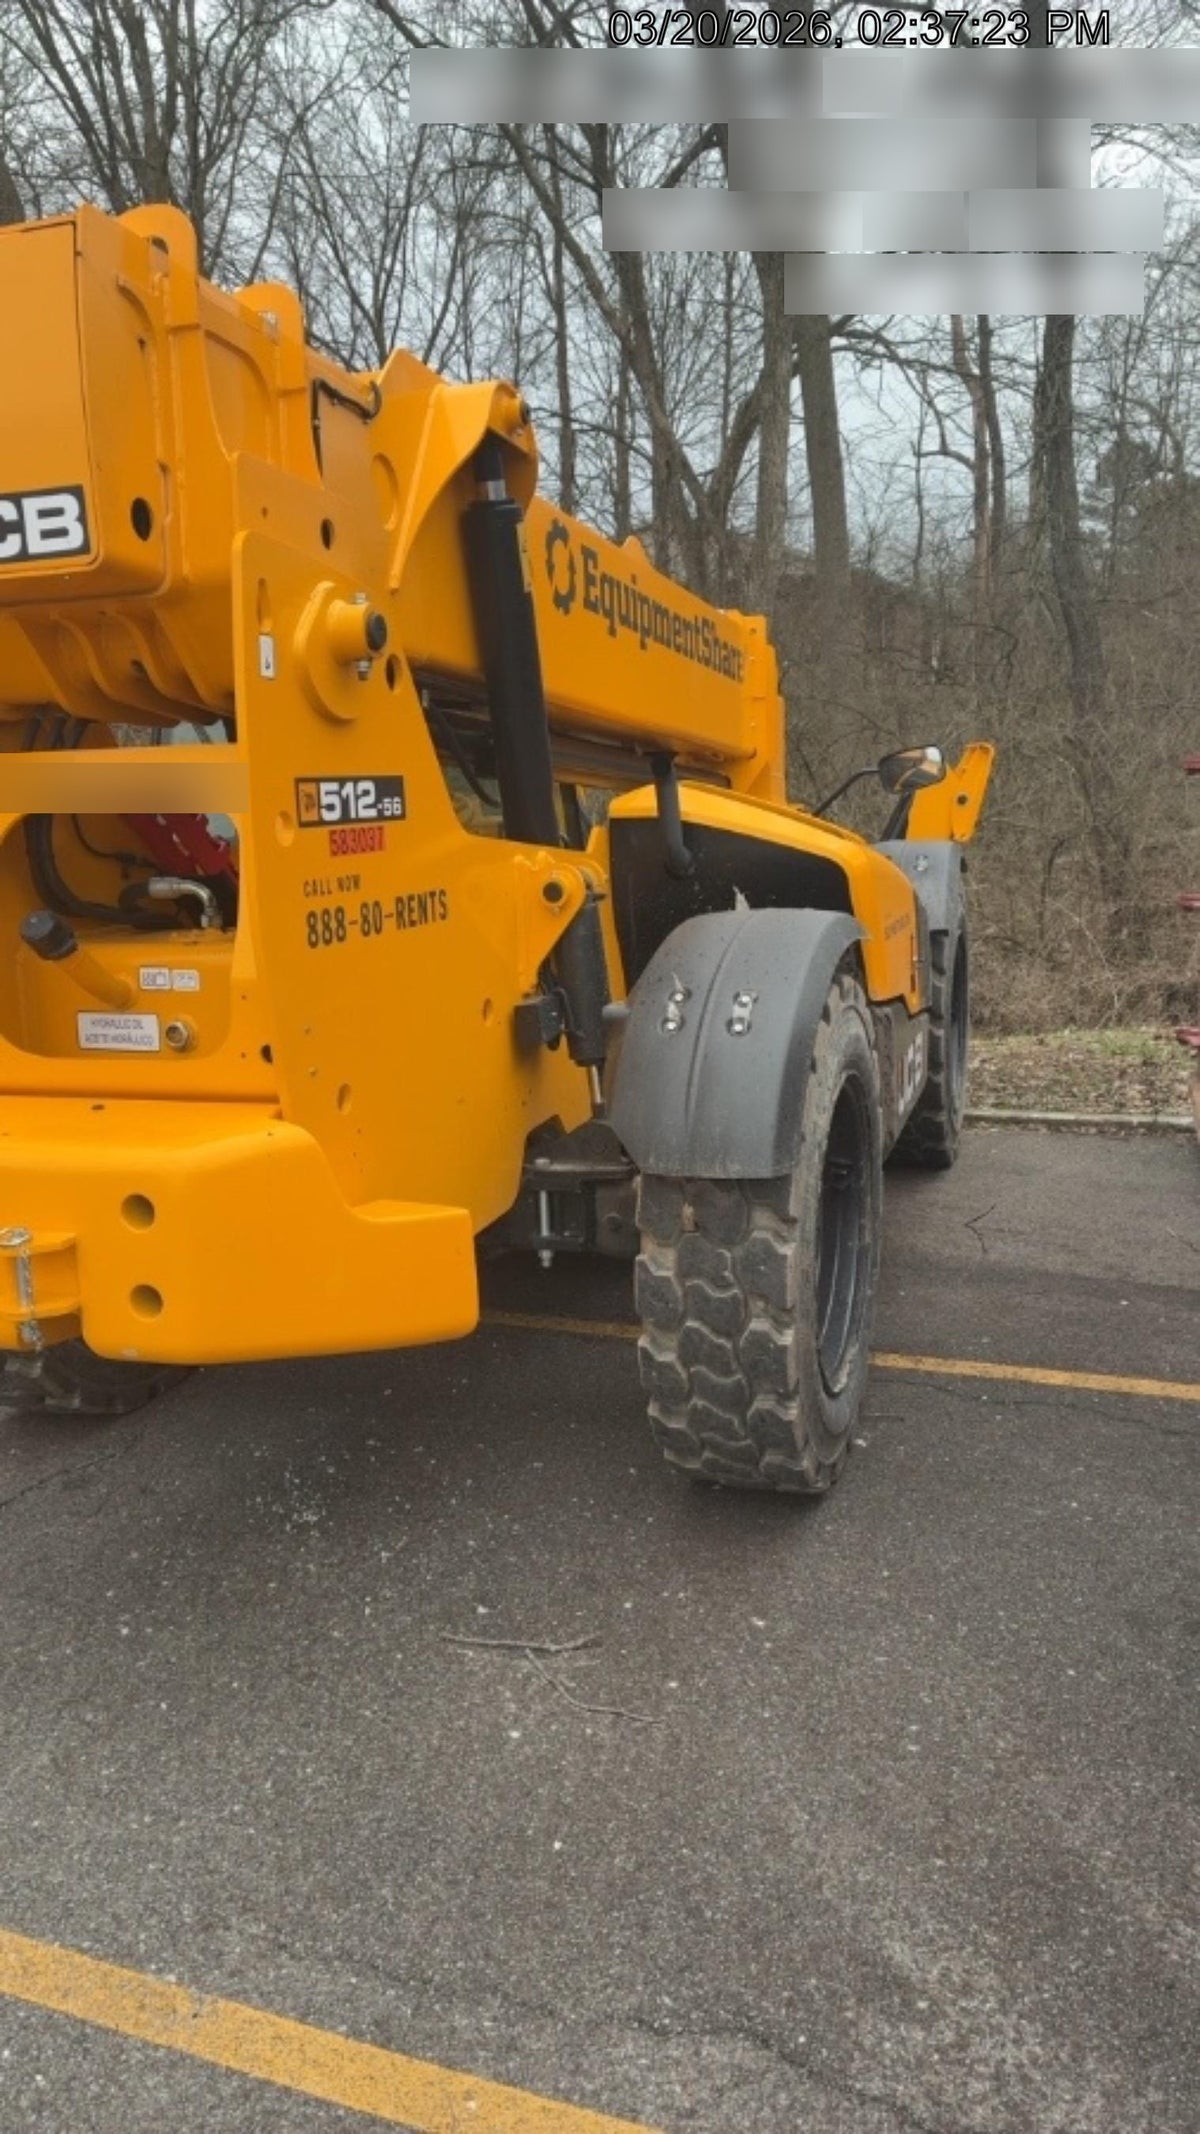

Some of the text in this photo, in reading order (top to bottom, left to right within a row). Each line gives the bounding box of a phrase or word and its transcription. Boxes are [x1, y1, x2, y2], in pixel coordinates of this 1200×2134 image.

[580, 544, 744, 684] EquipmentShare
[330, 827, 384, 857] 583037
[303, 874, 361, 898] CALL NOW
[306, 888, 448, 949] 888-80-RENTS
